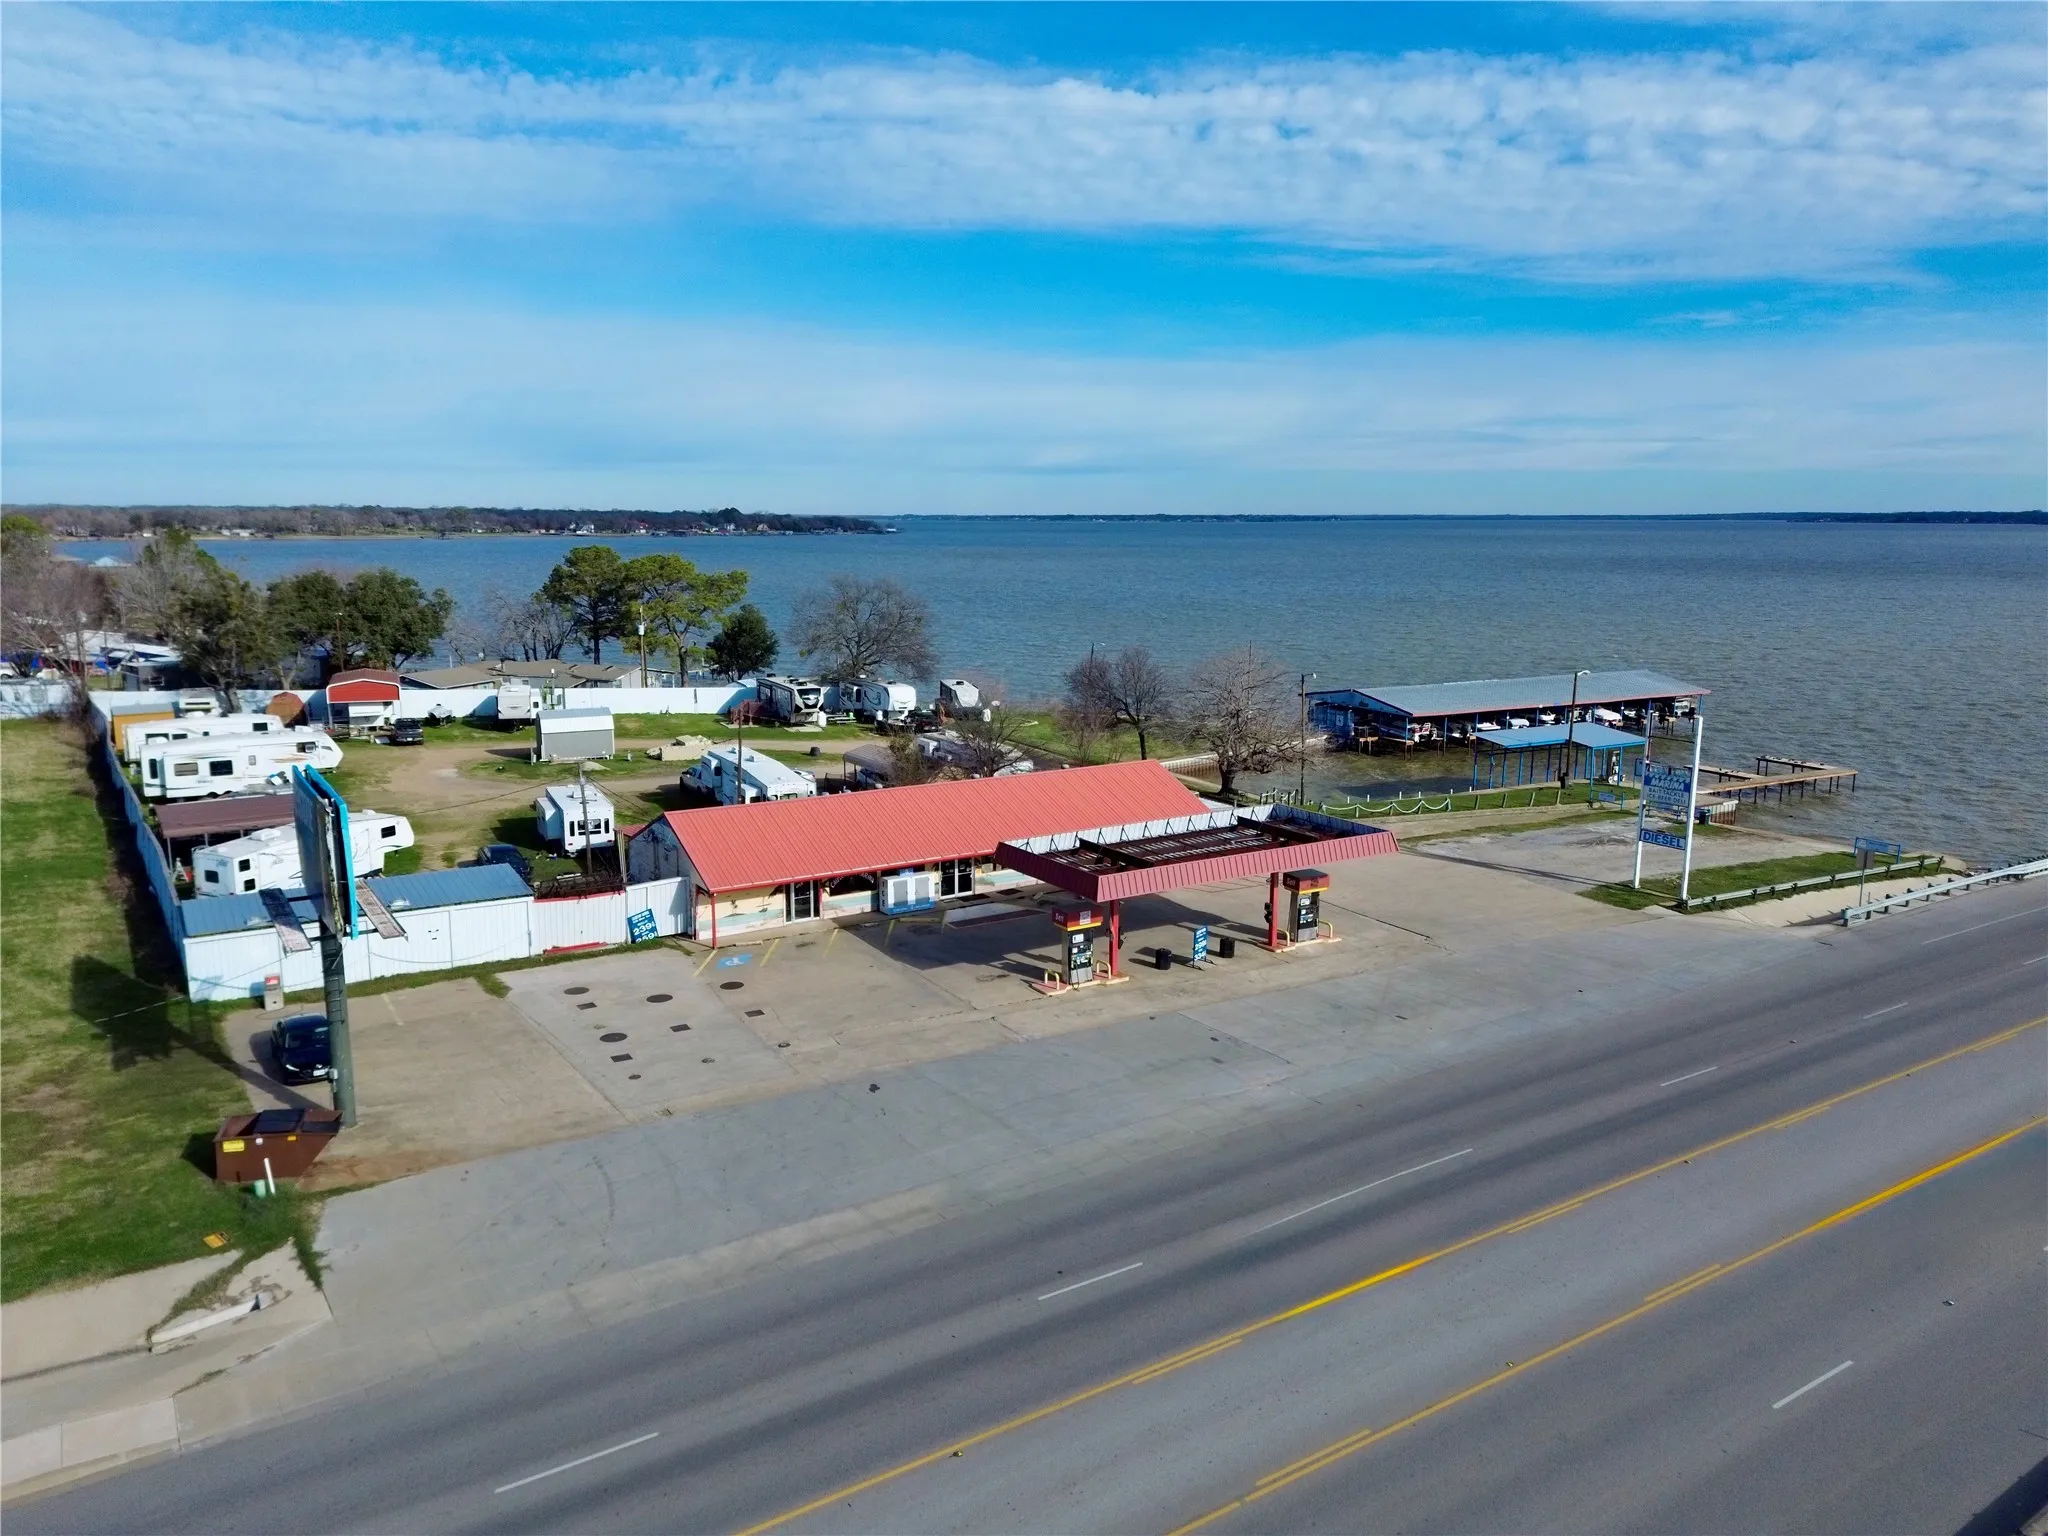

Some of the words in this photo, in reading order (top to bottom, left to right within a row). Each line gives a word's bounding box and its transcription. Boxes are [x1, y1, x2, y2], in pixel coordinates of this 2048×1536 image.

[1651, 779, 1684, 790] MARINA
[1663, 789, 1684, 798] TACKLE
[1644, 832, 1683, 848] DIESEL
